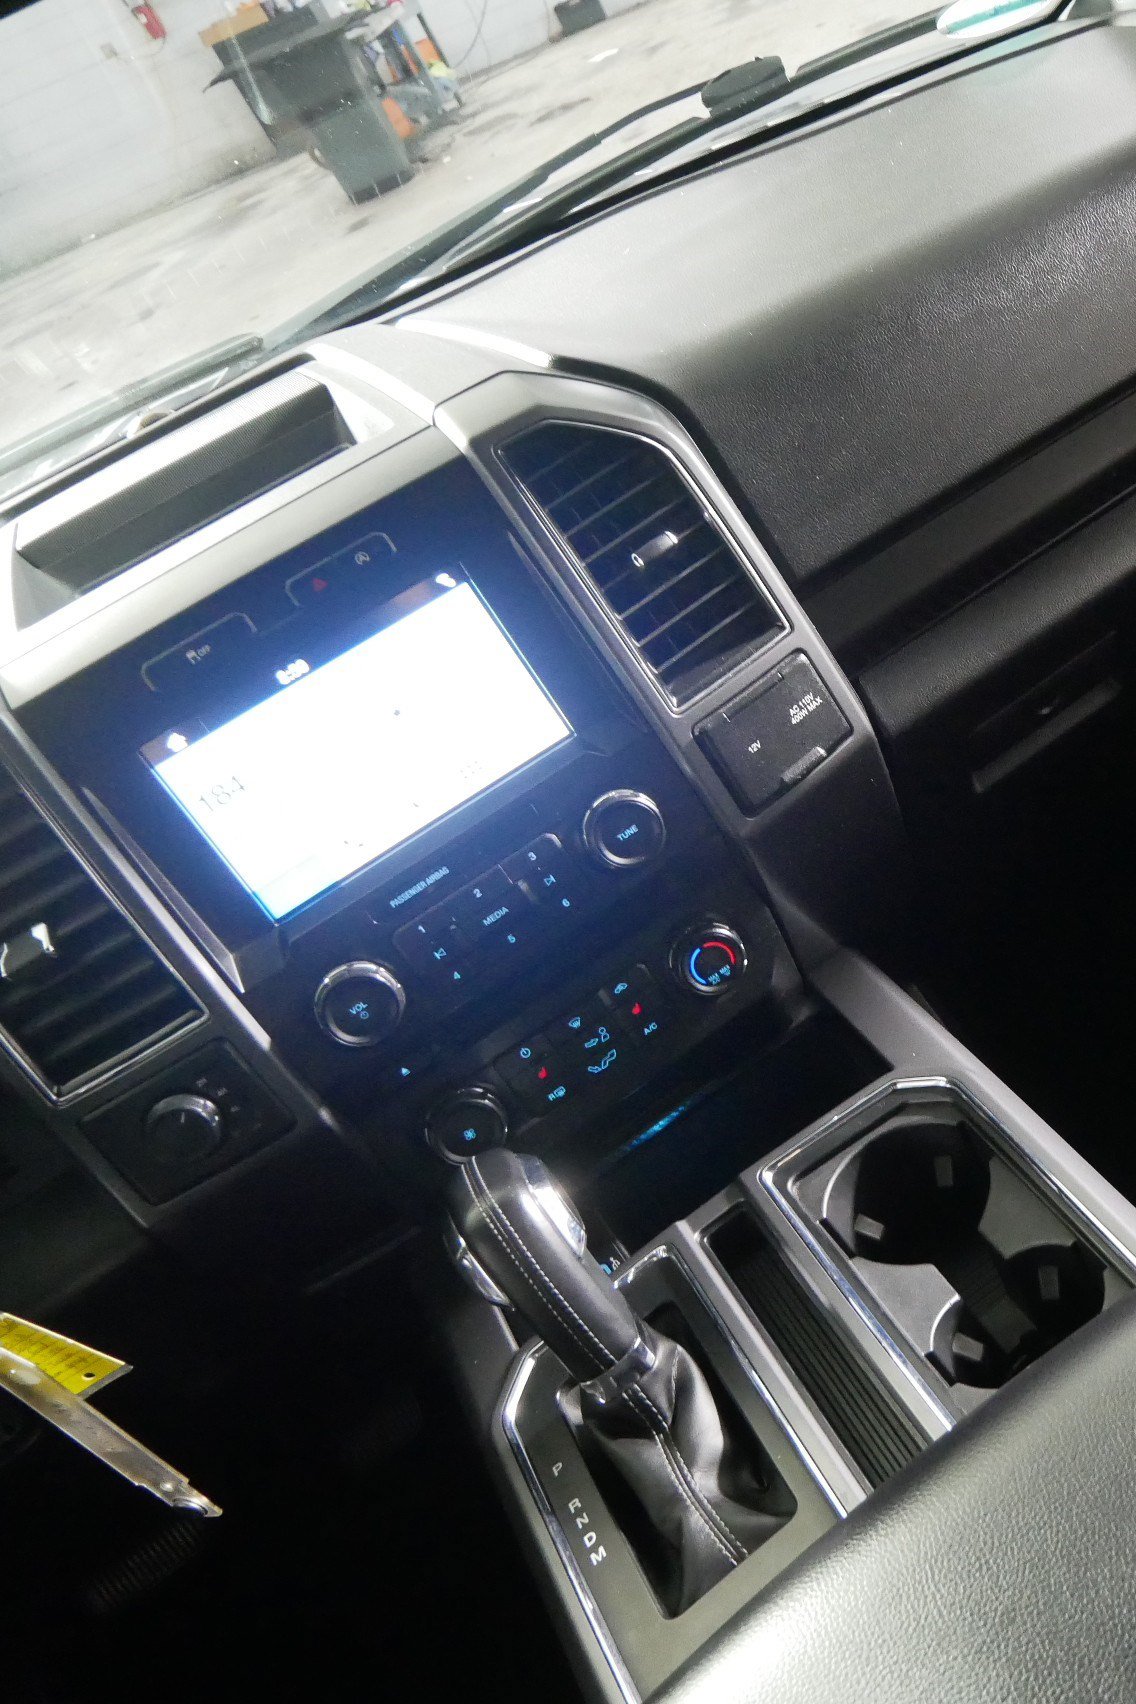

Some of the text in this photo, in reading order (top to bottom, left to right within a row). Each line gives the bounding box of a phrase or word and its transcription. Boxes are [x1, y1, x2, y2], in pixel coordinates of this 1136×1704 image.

[806, 695, 823, 712] MAX
[748, 739, 761, 754] 12V
[616, 824, 639, 841] TUNE
[528, 851, 537, 861] 3
[389, 866, 450, 908] PASSENGER AIRBAG
[473, 888, 483, 898] 2
[482, 906, 510, 927] MEDIA
[418, 925, 426, 934] 1
[349, 1001, 368, 1015] VOL
[643, 1022, 658, 1036] A/C
[552, 1462, 563, 1477] P
[568, 1498, 582, 1514] R
[575, 1512, 589, 1529] N
[583, 1531, 597, 1548] D
[589, 1545, 607, 1566] M
